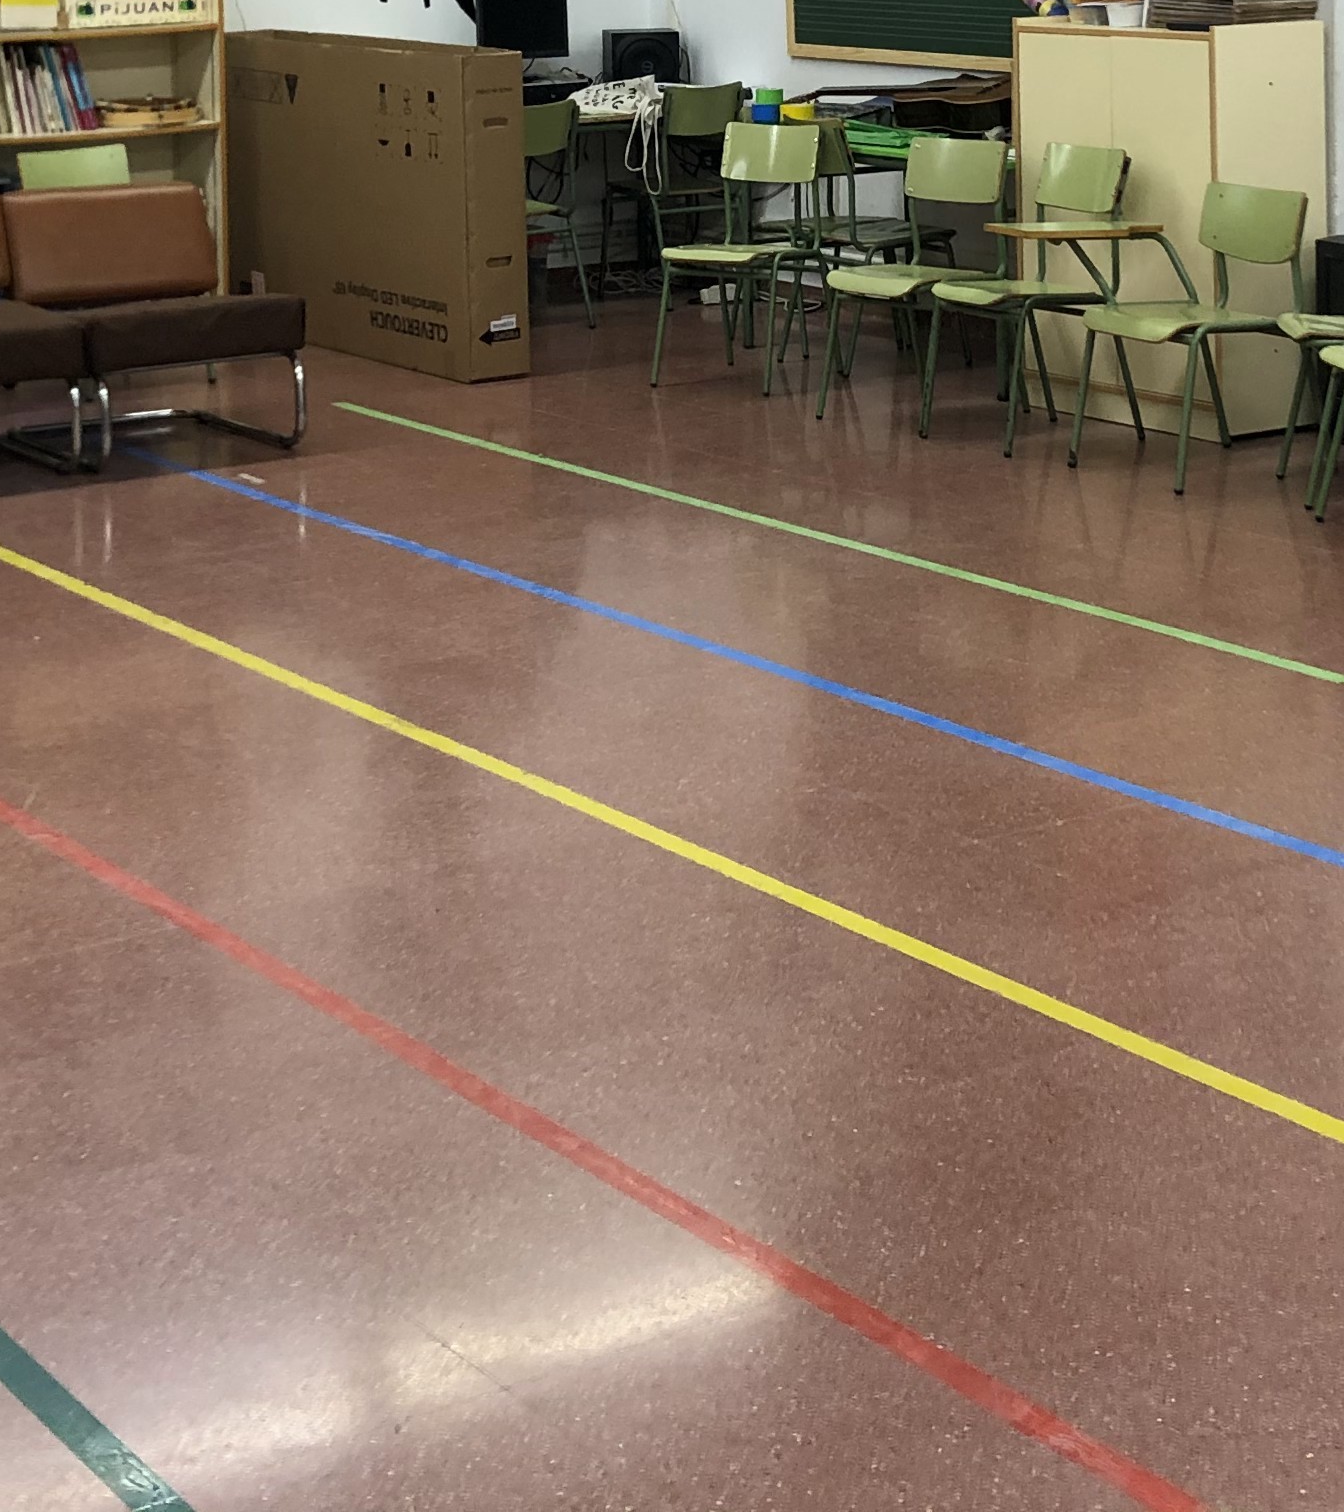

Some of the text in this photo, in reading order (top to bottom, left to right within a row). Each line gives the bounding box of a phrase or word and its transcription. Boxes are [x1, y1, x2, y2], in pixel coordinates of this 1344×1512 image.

[348, 280, 378, 303] Display
[380, 290, 399, 306] LED
[400, 295, 448, 316] Interactive
[370, 310, 449, 344] CLEVERTOUCH
